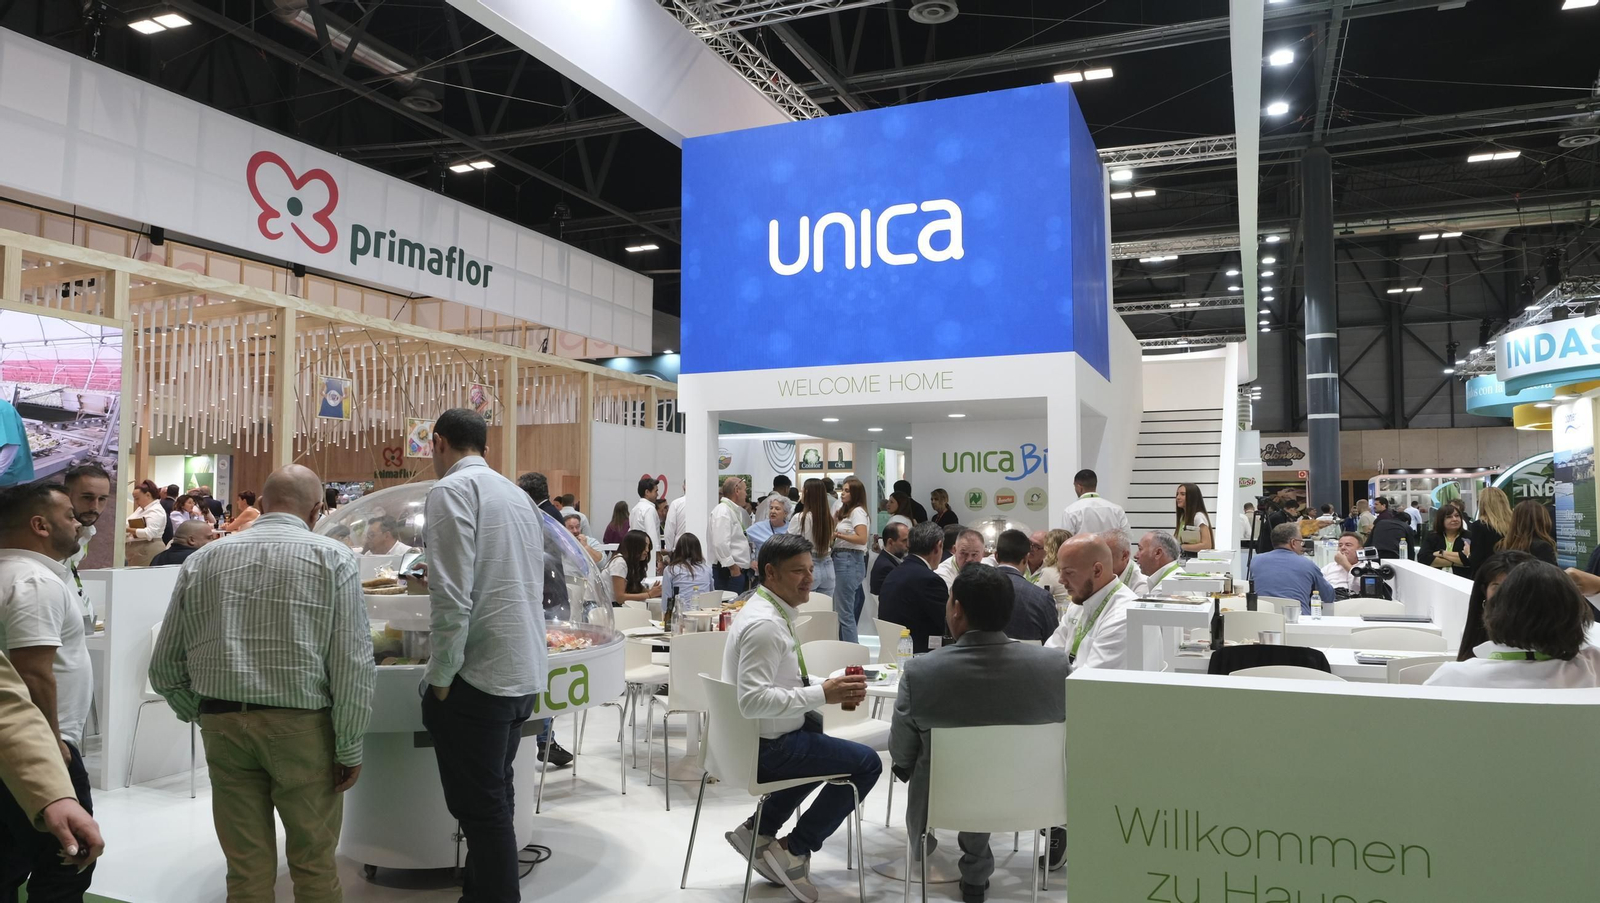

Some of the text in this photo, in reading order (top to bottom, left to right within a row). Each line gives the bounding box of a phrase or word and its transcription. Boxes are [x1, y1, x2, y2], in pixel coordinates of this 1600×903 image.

[350, 224, 493, 288] primaflor
[777, 371, 953, 396] WELCOME HOME
[1115, 805, 1431, 878] Willkommen
[1147, 872, 1200, 903] zu
